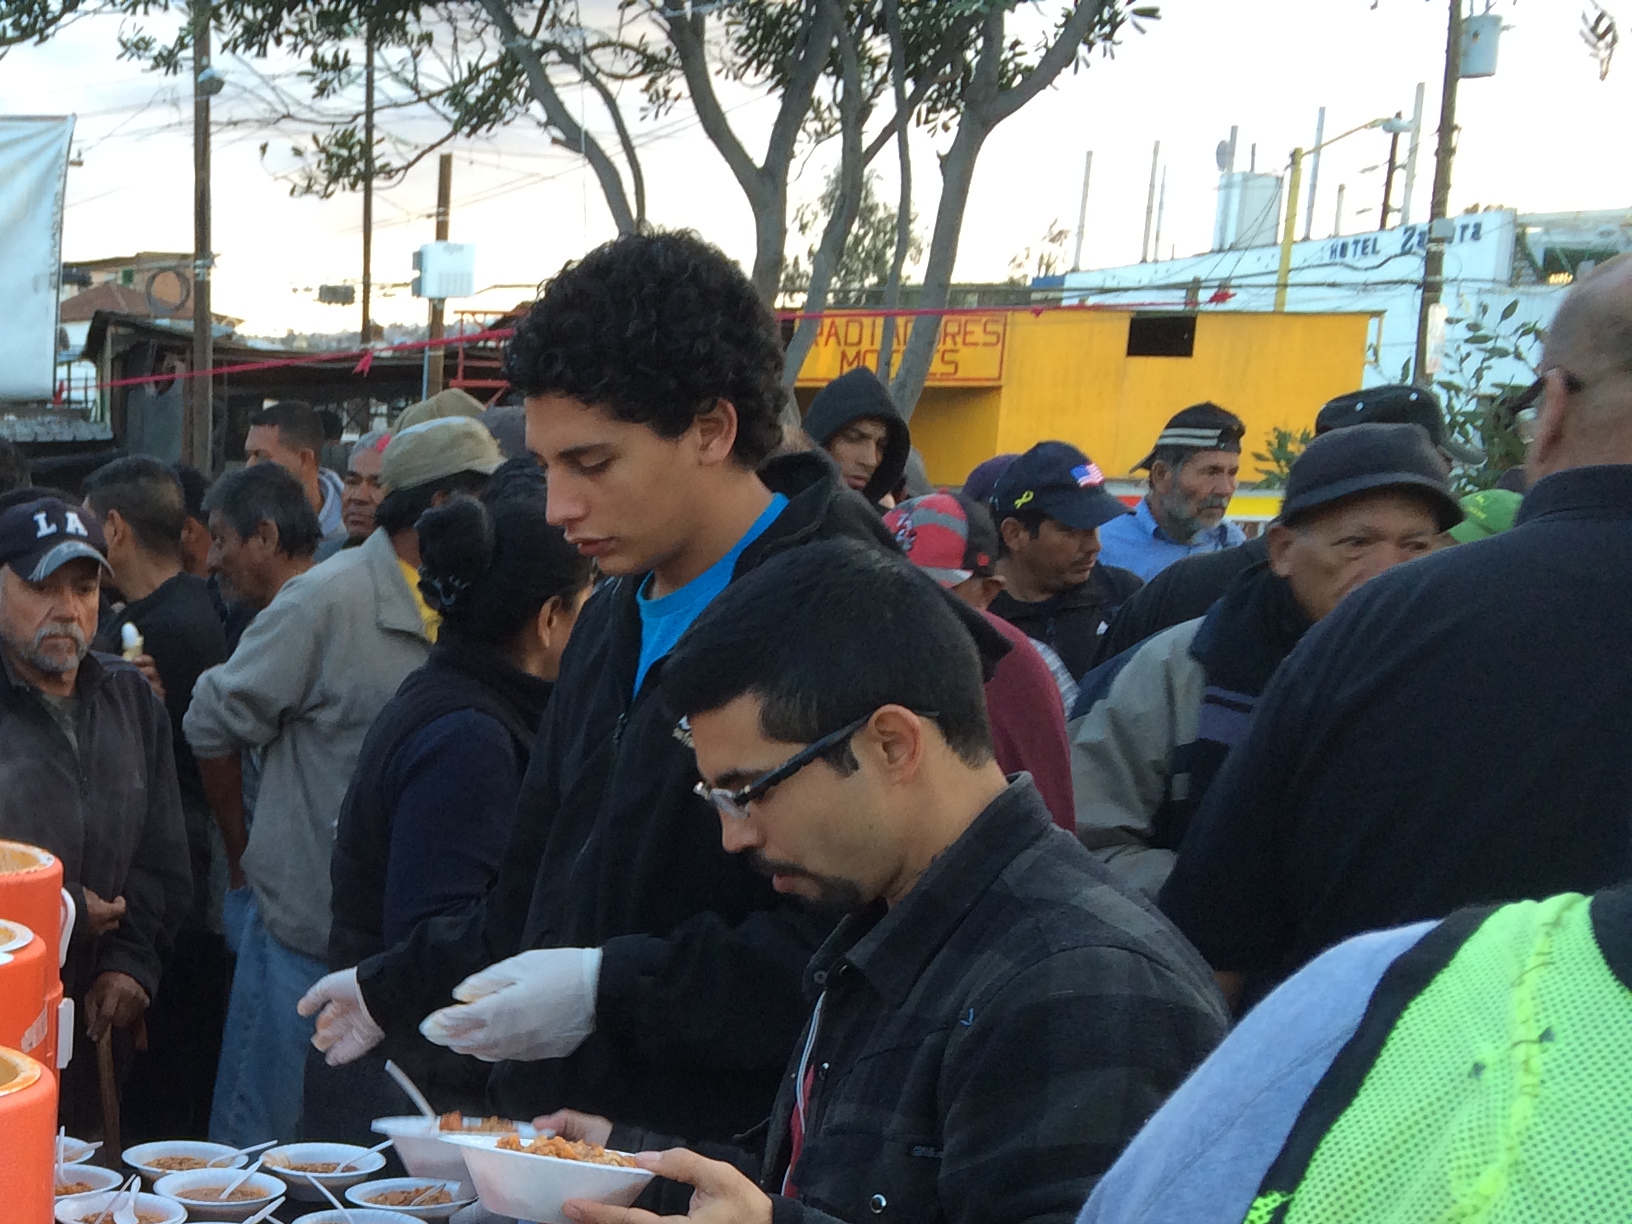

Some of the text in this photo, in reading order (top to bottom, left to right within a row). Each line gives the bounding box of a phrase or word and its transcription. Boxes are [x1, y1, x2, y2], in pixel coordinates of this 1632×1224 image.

[1329, 222, 1483, 261] HOTEL Zara
[33, 511, 88, 538] LA
